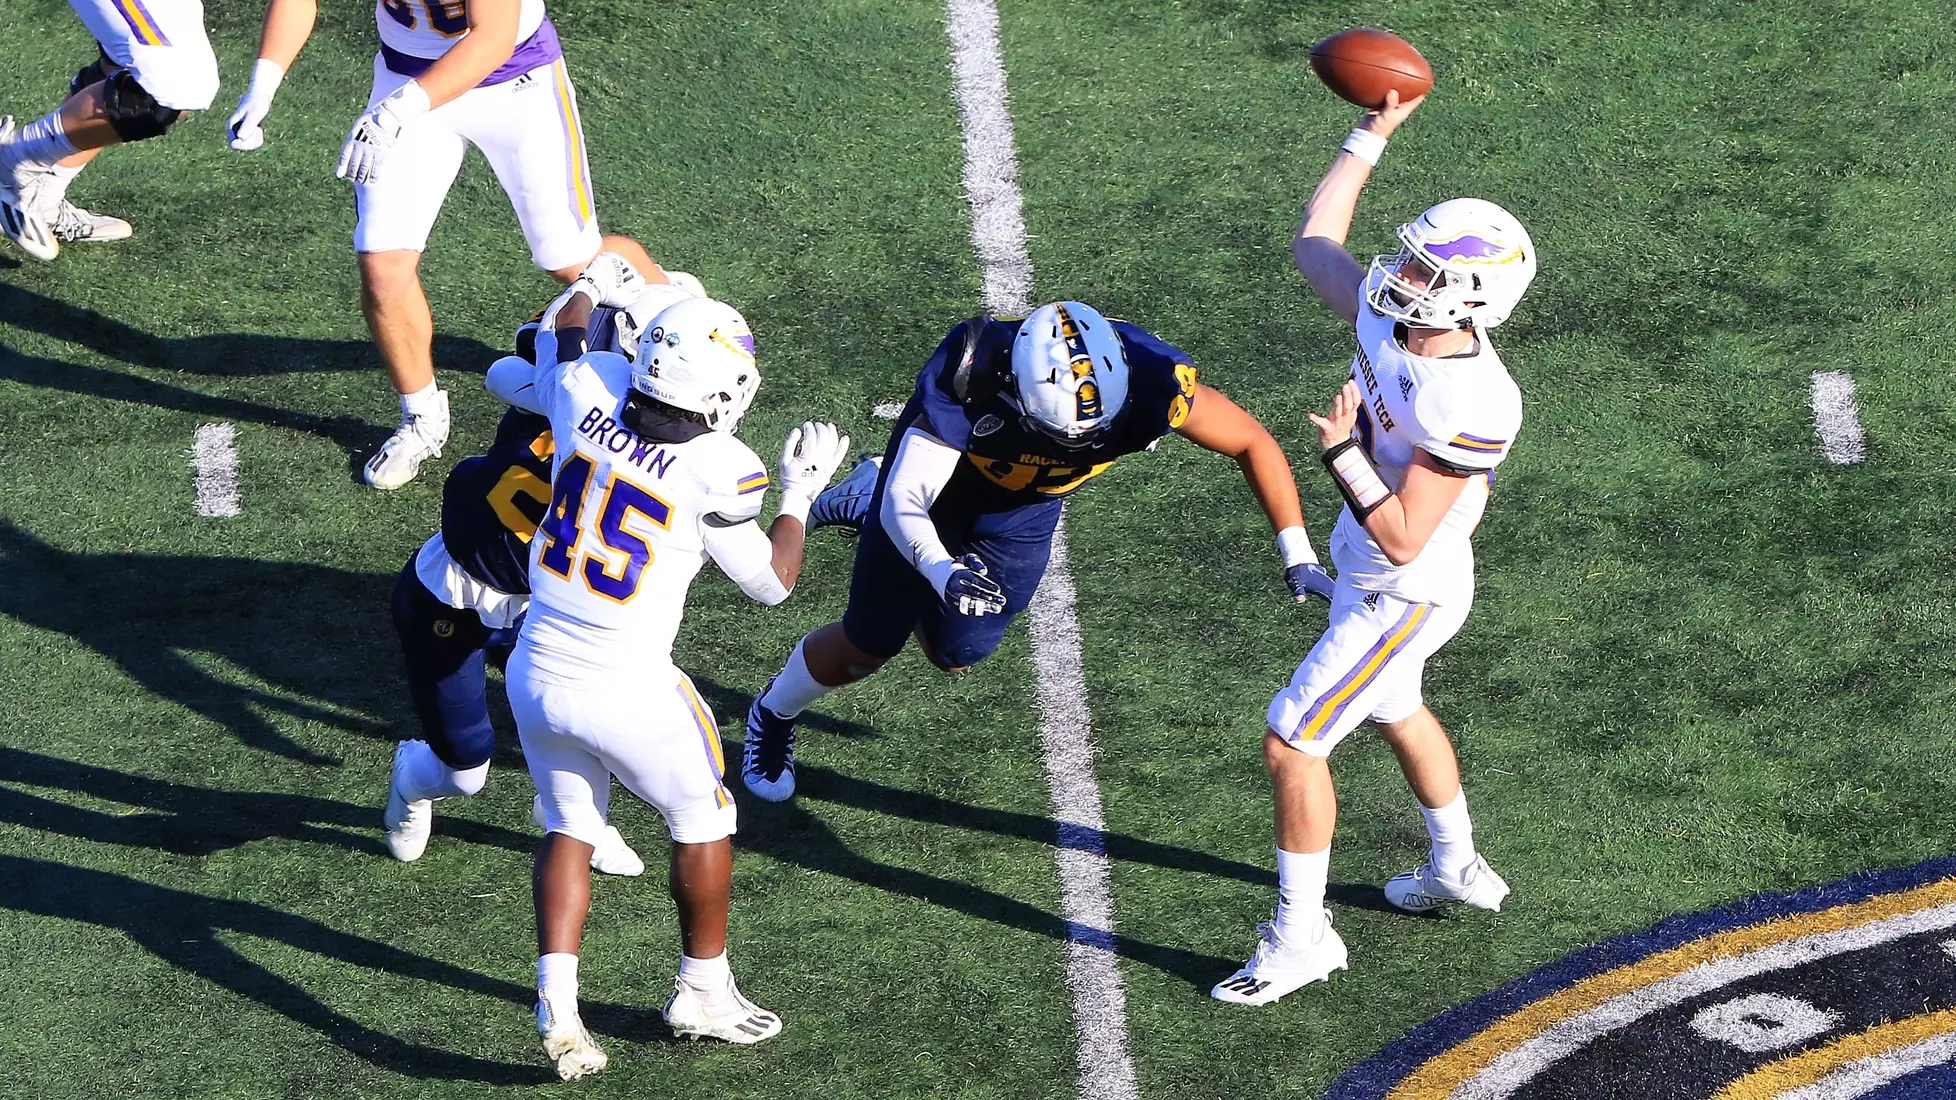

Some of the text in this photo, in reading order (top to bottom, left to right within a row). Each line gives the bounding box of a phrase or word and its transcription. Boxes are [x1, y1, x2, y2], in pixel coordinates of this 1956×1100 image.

[647, 365, 660, 378] 45
[1372, 393, 1396, 433] TECH
[578, 406, 677, 480] BROWN
[536, 449, 676, 606] 45
